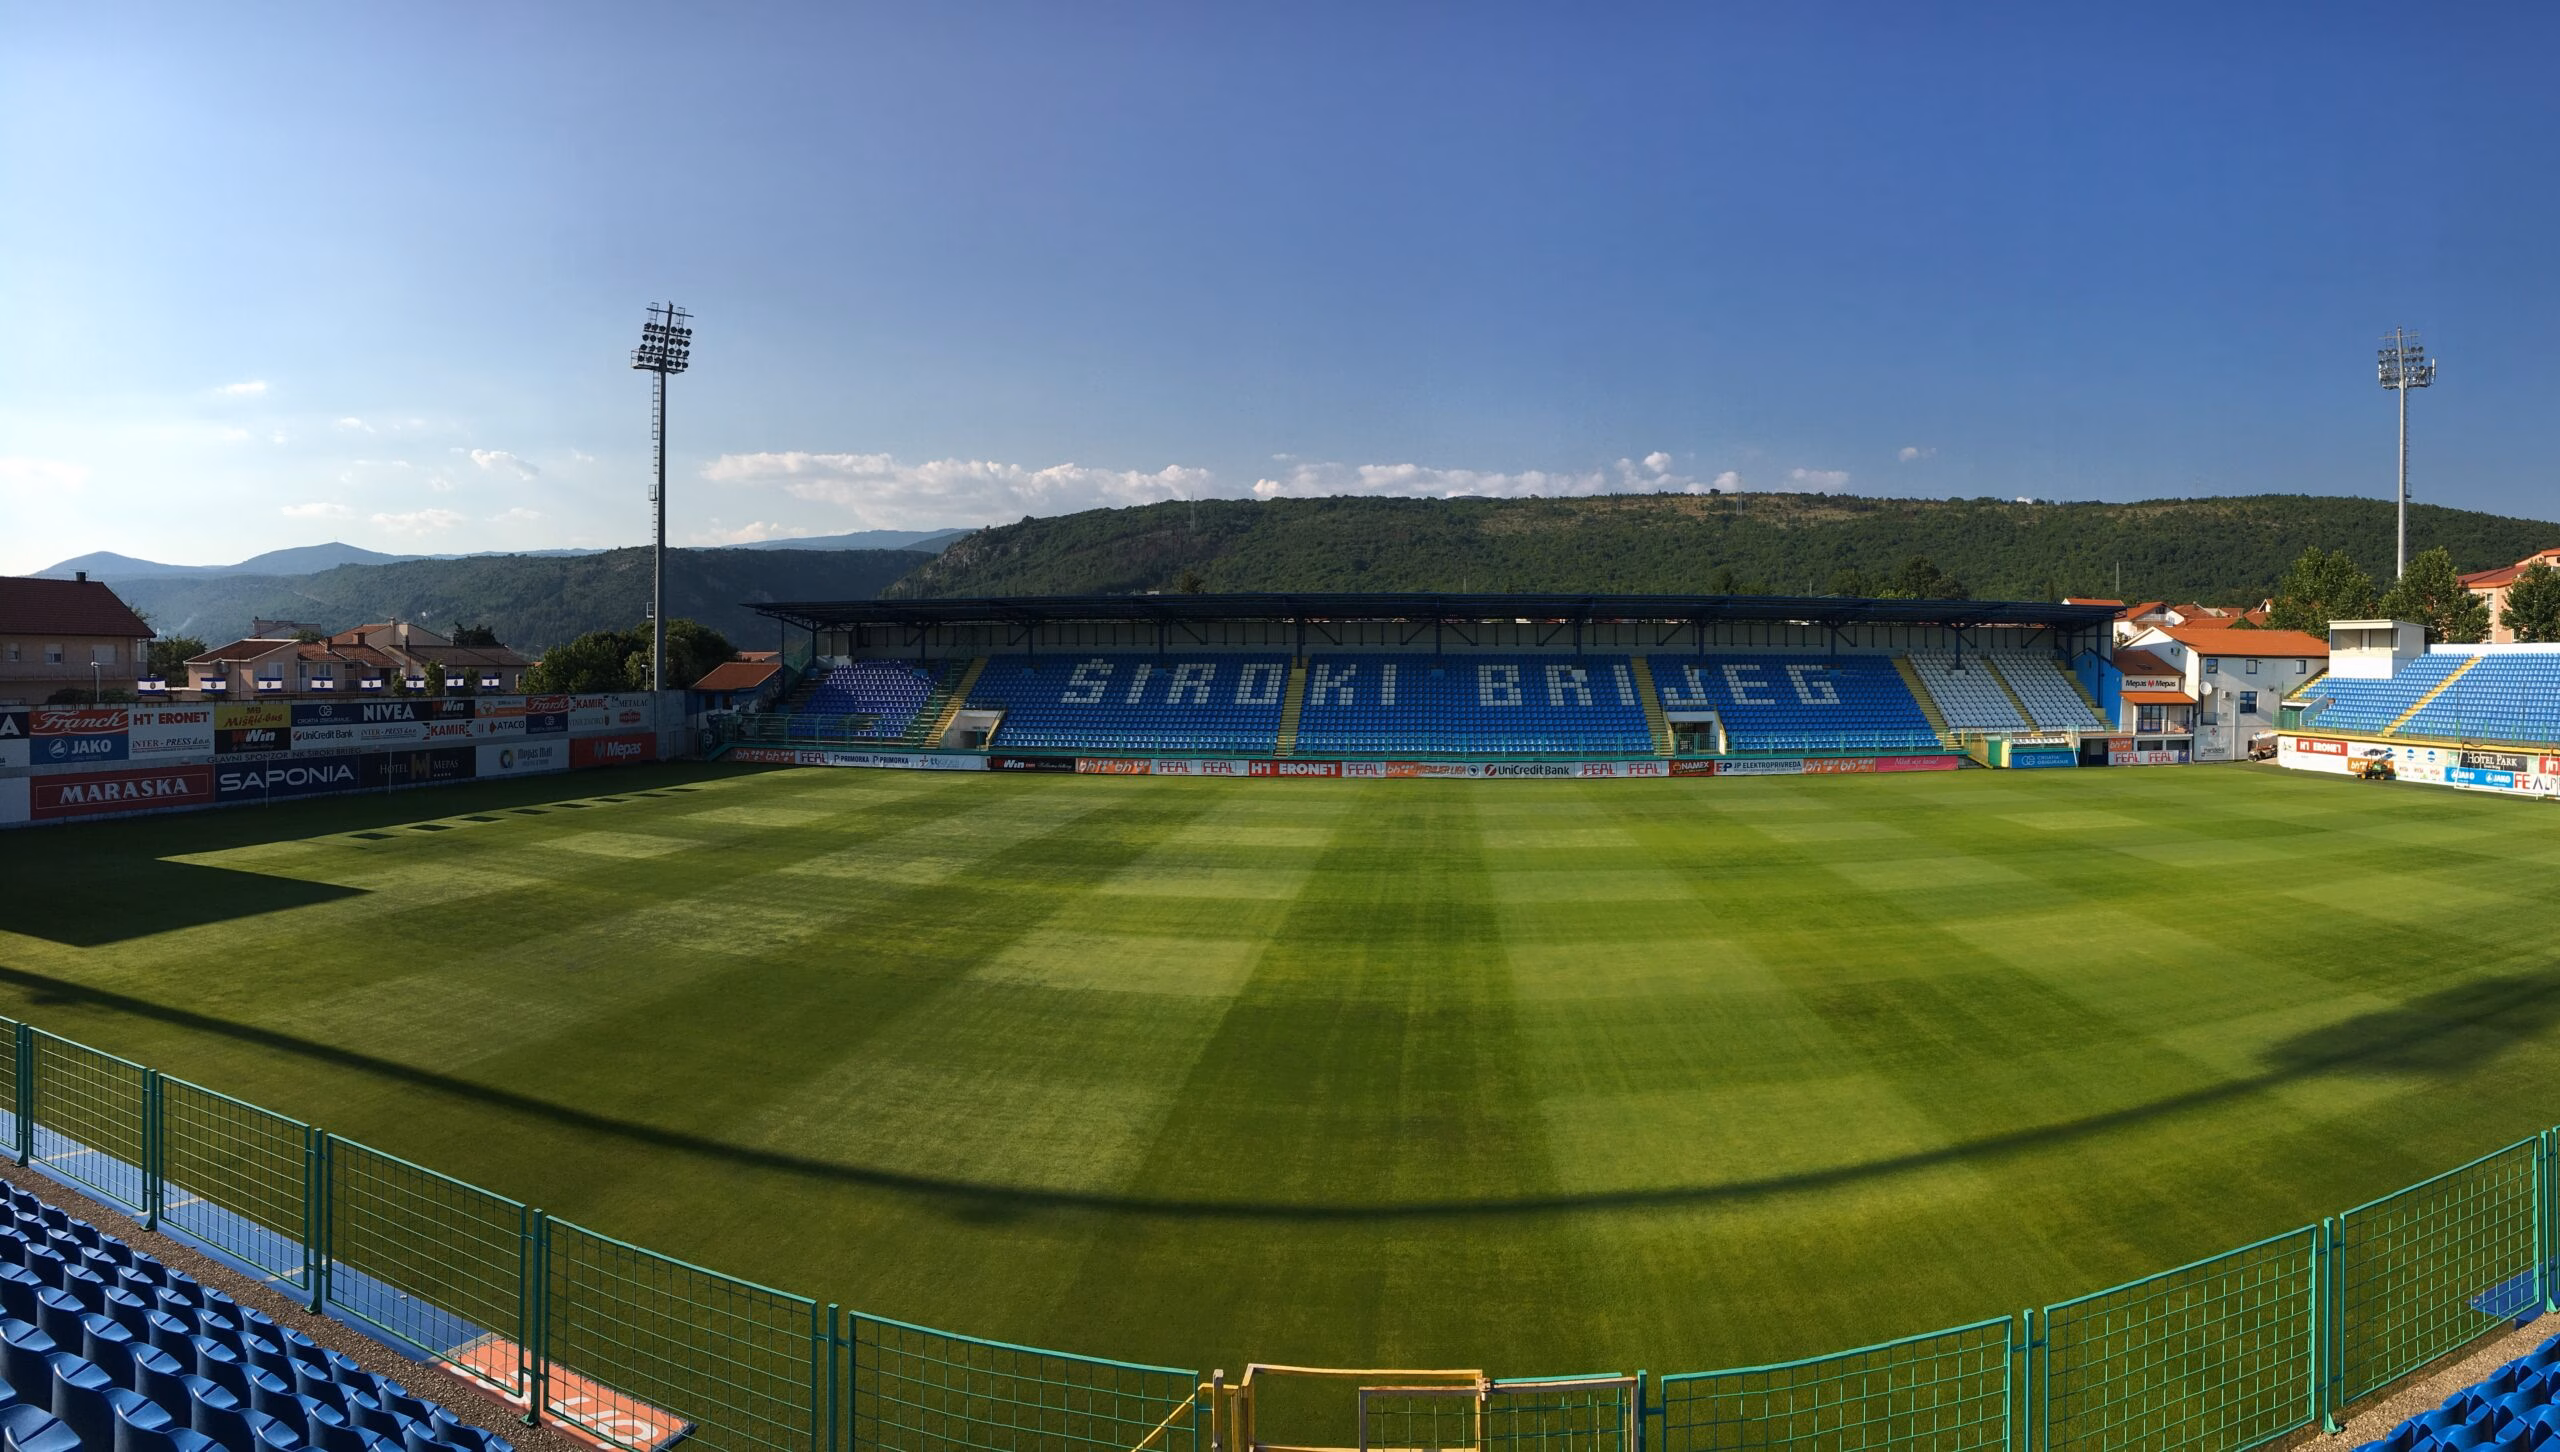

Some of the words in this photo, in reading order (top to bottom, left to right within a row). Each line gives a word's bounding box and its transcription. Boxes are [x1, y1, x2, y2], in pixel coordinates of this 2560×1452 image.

[2126, 680, 2146, 688] Mepas
[2155, 680, 2176, 688] Mepas
[577, 698, 604, 709] KAMIR
[363, 703, 415, 721] NIVEA
[32, 711, 128, 730] Franck
[133, 713, 153, 725] HT
[158, 712, 210, 724] ERONET
[431, 724, 466, 736] KAMIR
[497, 721, 525, 730] ATACO
[302, 730, 335, 741] UniCredit
[336, 729, 354, 739] Bank
[72, 740, 112, 755] JAKO
[166, 738, 192, 746] PRESS
[607, 741, 642, 759] Mepas
[207, 753, 242, 764] GLAVNI
[246, 751, 289, 762] SPONZOR
[801, 753, 827, 763] FEAL
[2115, 752, 2141, 763] FEAL
[2467, 752, 2494, 765] HOTEL
[2496, 754, 2517, 767] PARK
[380, 763, 408, 775] HOTEL
[1159, 761, 1190, 773] FEAL
[1203, 761, 1234, 773] FEAL
[1251, 763, 1271, 774] HT
[1279, 763, 1339, 775] ERONET
[1347, 764, 1379, 776] FEAL
[1498, 764, 1544, 776] UniCredit
[1545, 765, 1570, 776] Bank
[1584, 764, 1616, 776] FEAL
[1629, 763, 1660, 775] FEAL
[1681, 761, 1710, 770] NAMEX
[1744, 761, 1802, 770] ELEKTROPRIVREDA
[220, 765, 353, 791] SAPONIA
[60, 778, 189, 804] MARASKA
